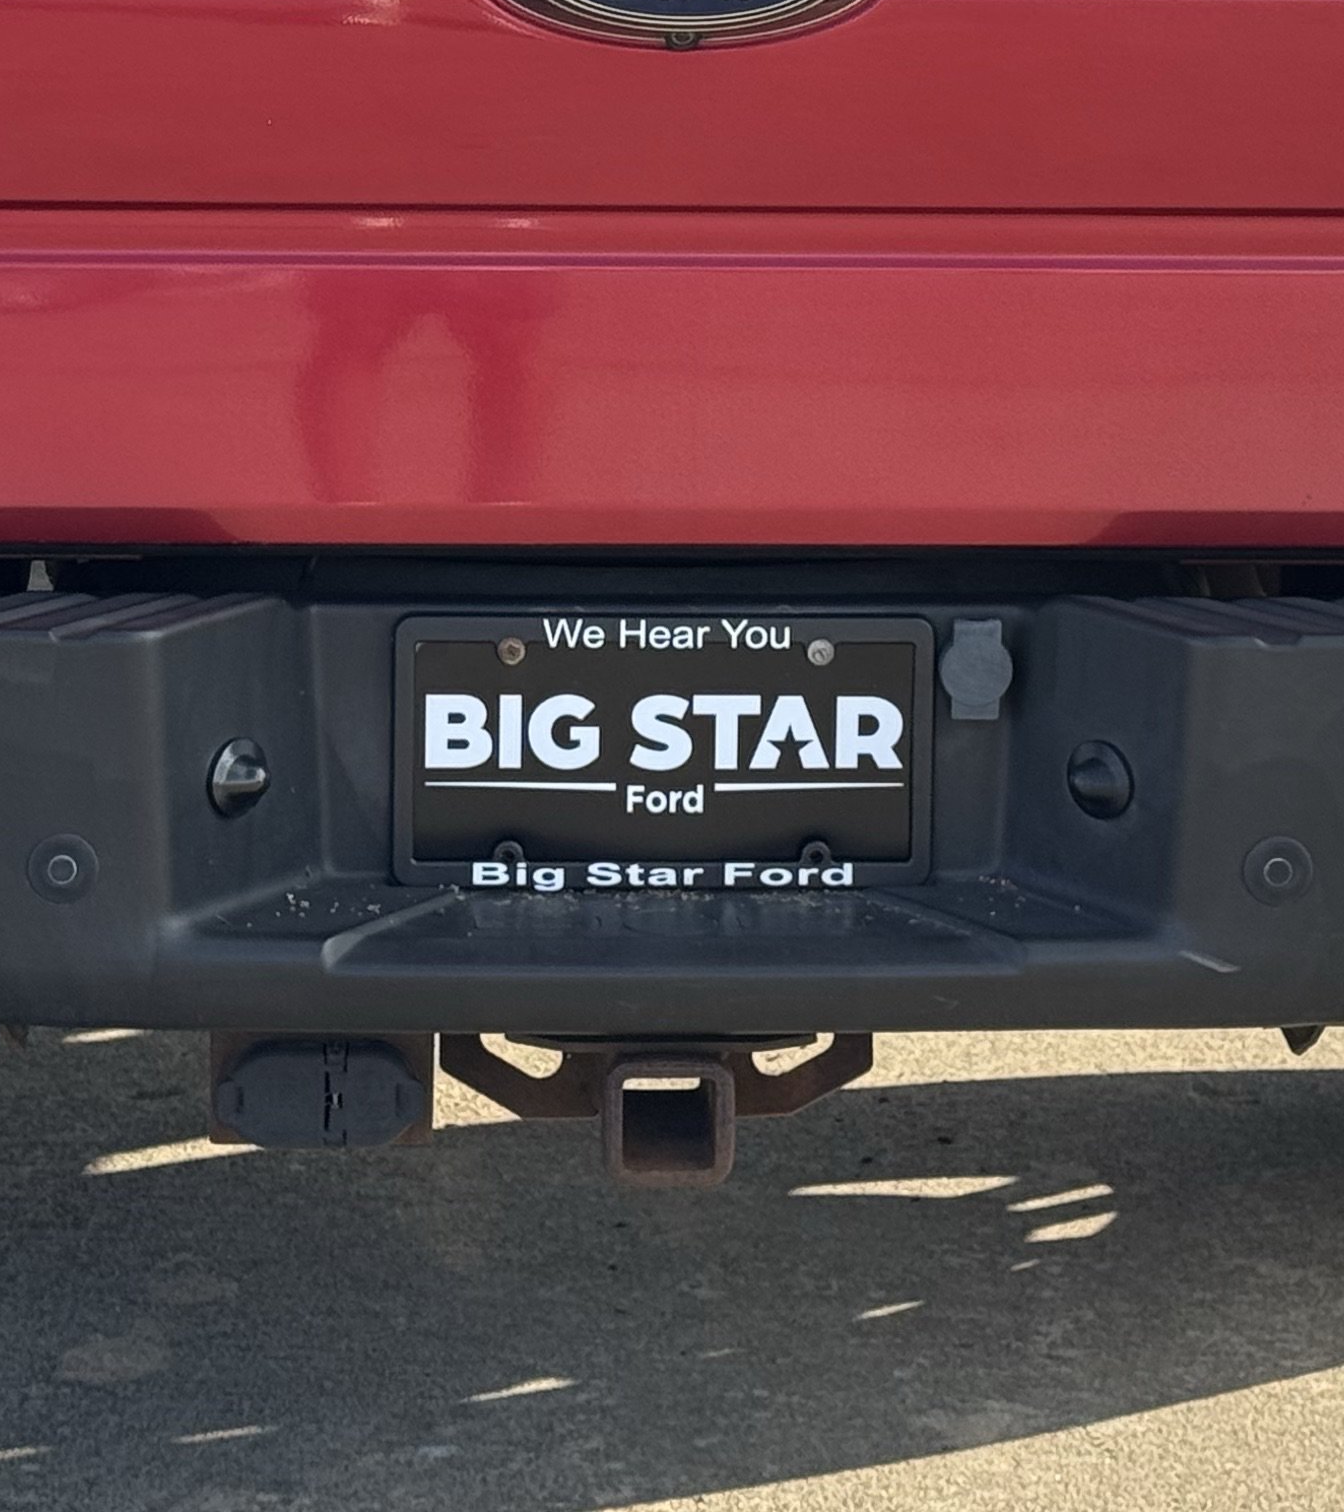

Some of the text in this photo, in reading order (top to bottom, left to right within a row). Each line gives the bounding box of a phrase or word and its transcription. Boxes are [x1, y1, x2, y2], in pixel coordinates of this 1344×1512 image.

[542, 618, 791, 650] We Hear You
[425, 694, 904, 771] BIG STAR
[626, 785, 705, 814] Ford
[471, 862, 854, 891] Big Star Ford
